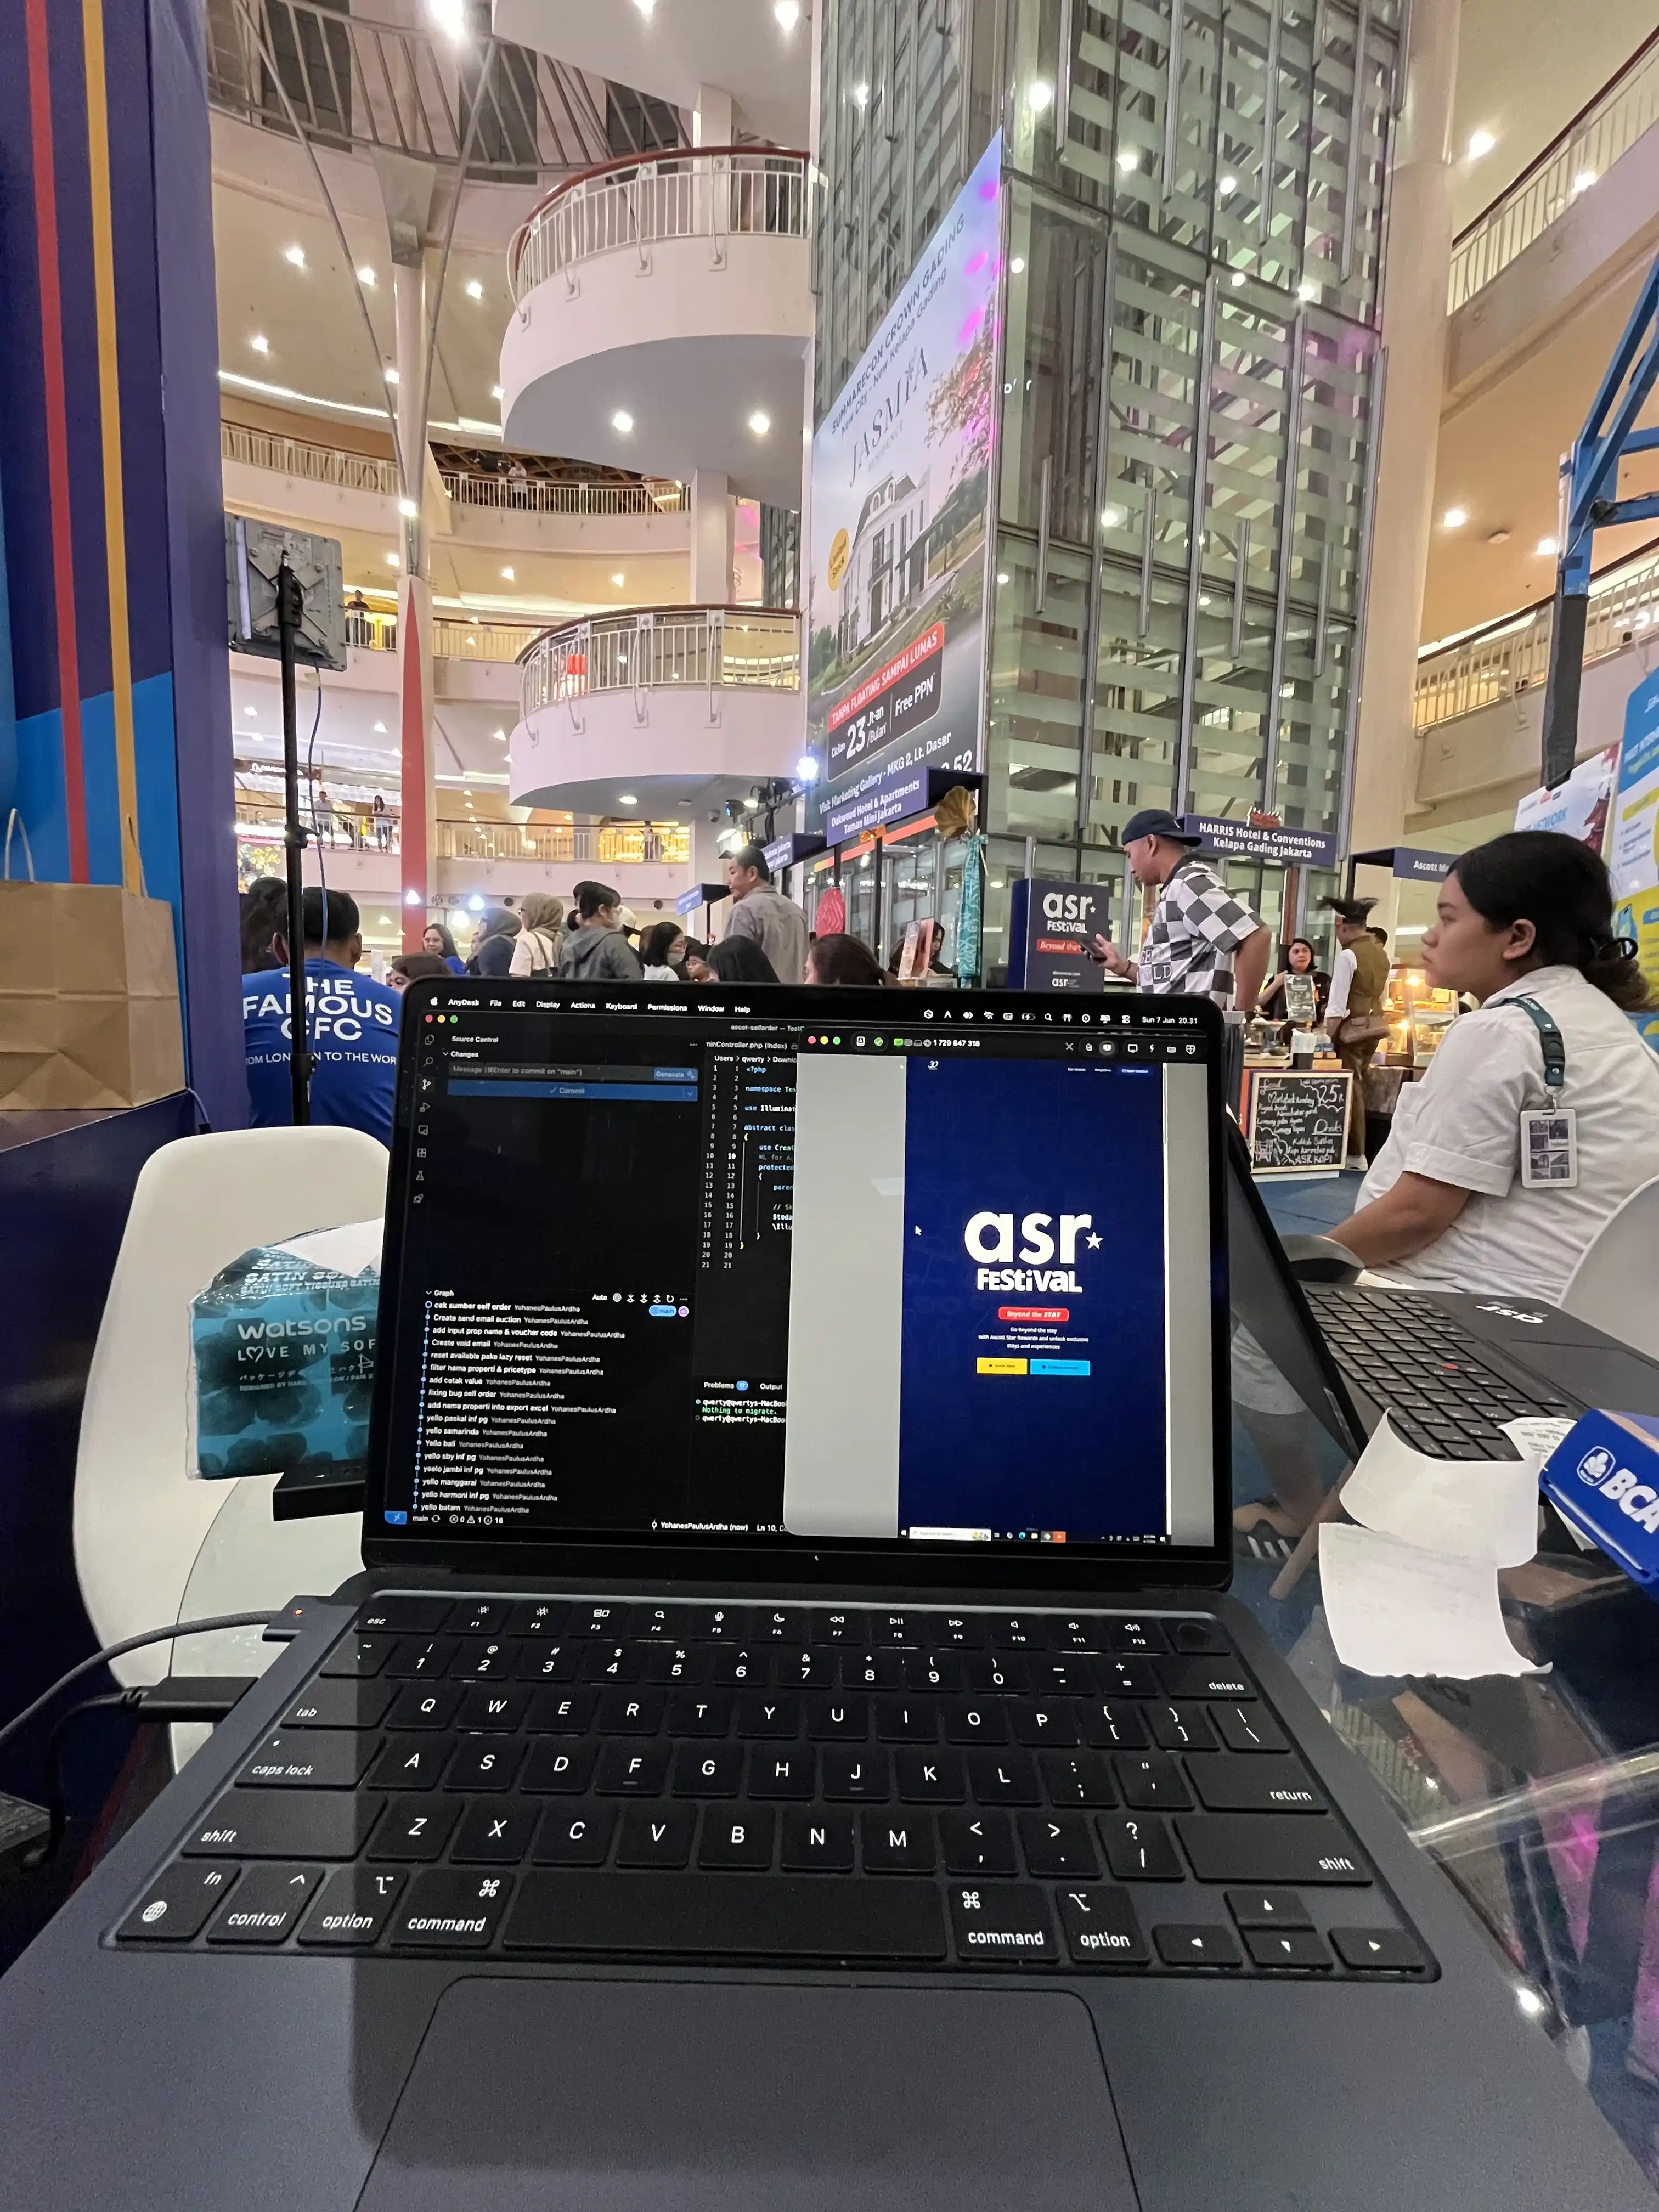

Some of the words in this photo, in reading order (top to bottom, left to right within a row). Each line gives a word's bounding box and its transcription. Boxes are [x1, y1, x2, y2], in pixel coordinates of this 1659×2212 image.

[917, 267, 947, 318] Gading
[832, 345, 883, 435] SUMMARECON
[885, 284, 920, 348] CROWN
[923, 213, 964, 289] GADING
[832, 702, 850, 725] TANPA
[851, 677, 881, 710] FLOATING
[882, 653, 909, 686] SAMPAI
[910, 630, 938, 664] LUNAS
[895, 695, 913, 716] Free
[846, 715, 866, 759] 23
[831, 781, 859, 810] Marketing
[860, 771, 882, 792] Gallery
[887, 756, 905, 777] MKG
[926, 731, 952, 755] Dasar
[831, 807, 856, 827] Oakwood
[857, 798, 873, 817] Hotel
[879, 779, 920, 809] Apartments
[844, 819, 862, 834] Taman
[864, 812, 877, 826] Mini
[877, 803, 902, 823] Jakarta
[1199, 822, 1234, 837] HARRIS
[1236, 827, 1261, 841] Hotel
[1262, 832, 1270, 841] &
[1272, 832, 1325, 848] Conventions
[1213, 837, 1245, 851] Kelapa
[1247, 842, 1278, 857] Gading
[1279, 845, 1312, 858] Jakarta
[1413, 860, 1437, 871] Ascott
[1043, 893, 1093, 920] asr
[1040, 941, 1065, 950] Beyond
[1052, 978, 1068, 987] asr
[448, 998, 479, 1007] AnyDesk
[536, 1001, 560, 1009] Display
[606, 1002, 637, 1011] Keyboard
[266, 1052, 321, 1063] LONN
[324, 1052, 342, 1061] TO
[345, 1052, 369, 1063] THE
[964, 1211, 1092, 1265] asr
[245, 1272, 308, 1283] SATIN
[434, 1289, 454, 1297] Graph
[1007, 1310, 1030, 1318] Beyond
[238, 1316, 366, 1340] watsons
[303, 1343, 329, 1356] MY
[341, 1339, 376, 1352] SOF
[428, 1389, 448, 1398] fixing
[448, 1390, 462, 1398] bug
[702, 1406, 731, 1415] Nothing
[1599, 1468, 1659, 1534] BCA
[416, 1658, 425, 1669] 1
[477, 1659, 490, 1671] 2
[1209, 1682, 1244, 1690] delete
[296, 1708, 317, 1717] tab
[421, 1698, 436, 1713] Q
[488, 1700, 507, 1713] W
[558, 1701, 572, 1714] E
[626, 1703, 639, 1716] R
[696, 1705, 708, 1718] T
[764, 1706, 775, 1719] Y
[404, 1753, 419, 1768] A
[480, 1754, 495, 1770] S
[554, 1756, 569, 1771] D
[252, 1765, 283, 1776] caps
[284, 1764, 314, 1775] lock
[1269, 1790, 1312, 1801] return
[408, 1818, 427, 1835] Z
[200, 1829, 237, 1843] shift
[1319, 1857, 1355, 1870] shift
[204, 1871, 222, 1885] fn
[228, 1912, 287, 1927] control
[322, 1913, 373, 1930] option
[408, 1917, 487, 1932] command
[968, 1931, 1044, 1945] command
[1080, 1931, 1131, 1949] option
